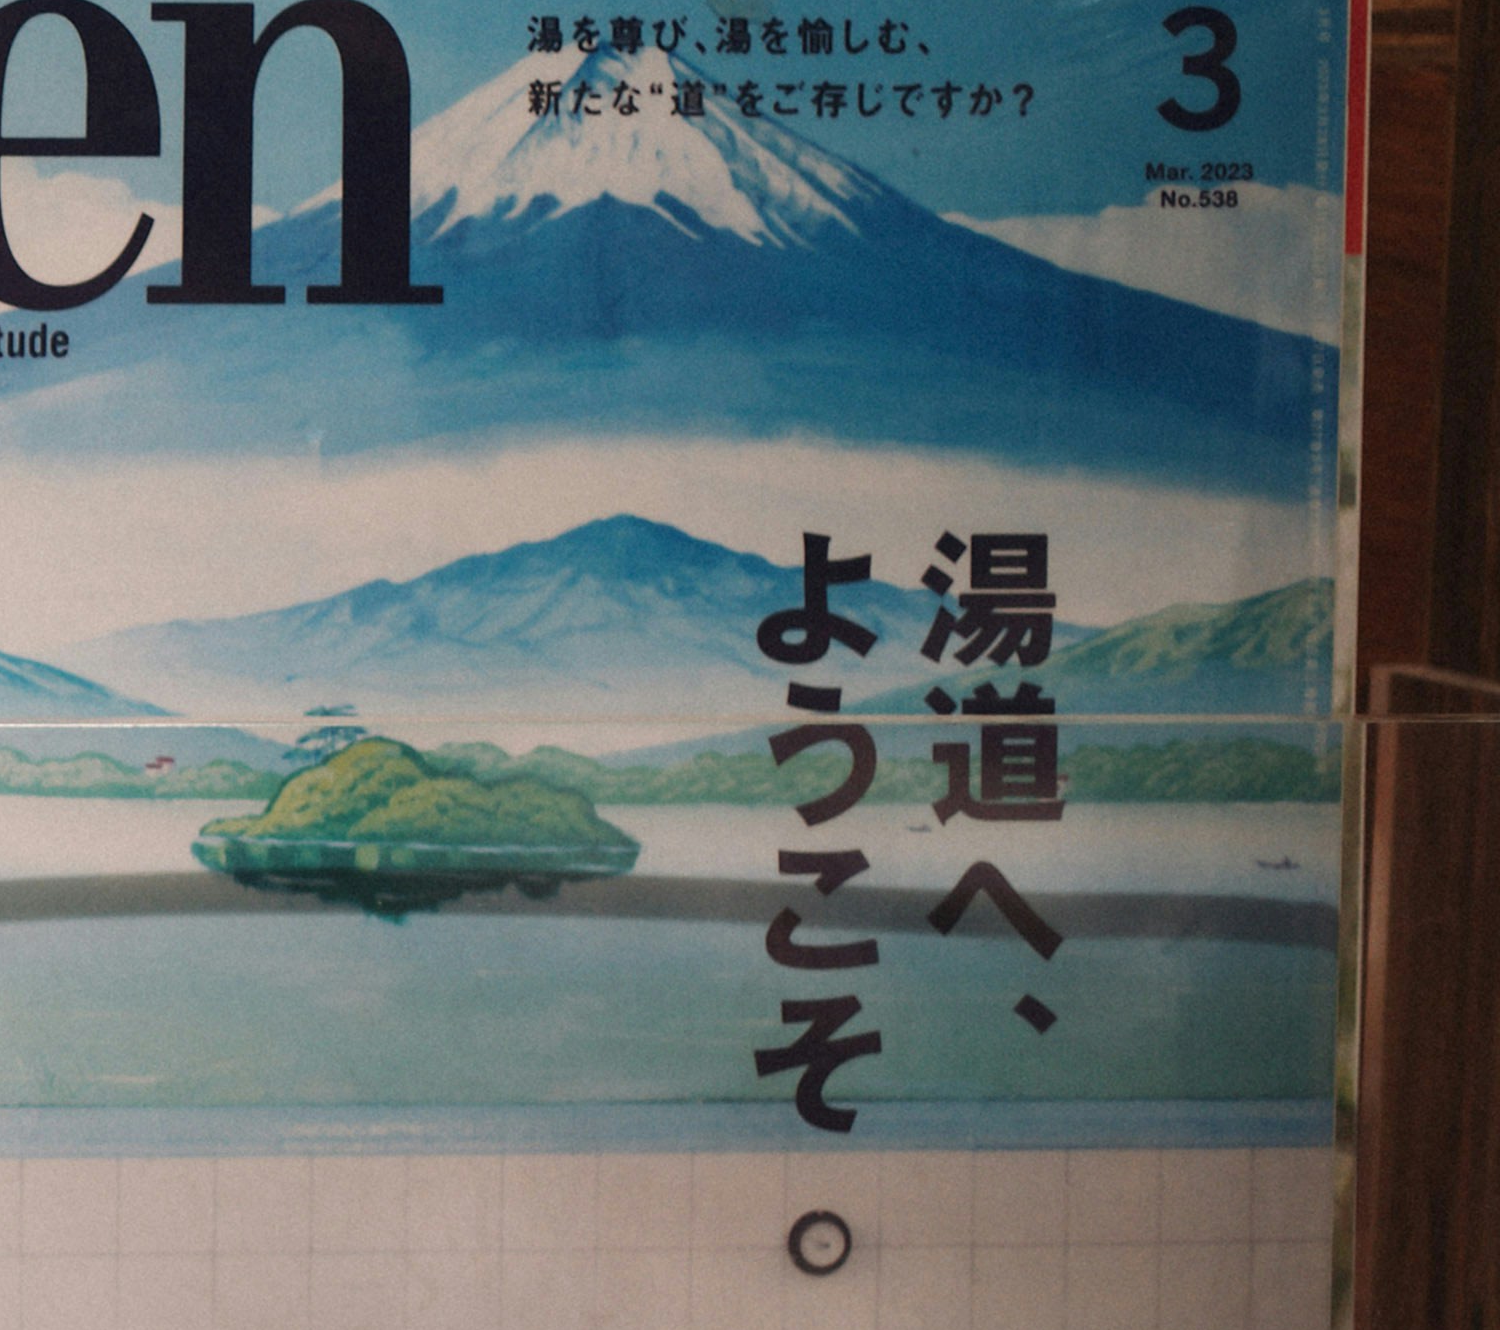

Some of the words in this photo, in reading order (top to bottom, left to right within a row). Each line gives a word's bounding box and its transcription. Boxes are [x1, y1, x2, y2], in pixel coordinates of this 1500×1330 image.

[527, 15, 932, 54] 湯を尊び、湯を愉しむ、
[1156, 5, 1242, 132] 3
[1145, 162, 1193, 182] Mar.
[1200, 162, 1255, 182] 2023
[1160, 190, 1239, 210] No.538
[919, 530, 1065, 1035] 湯道へ、
[754, 530, 883, 1135] ようこそ
